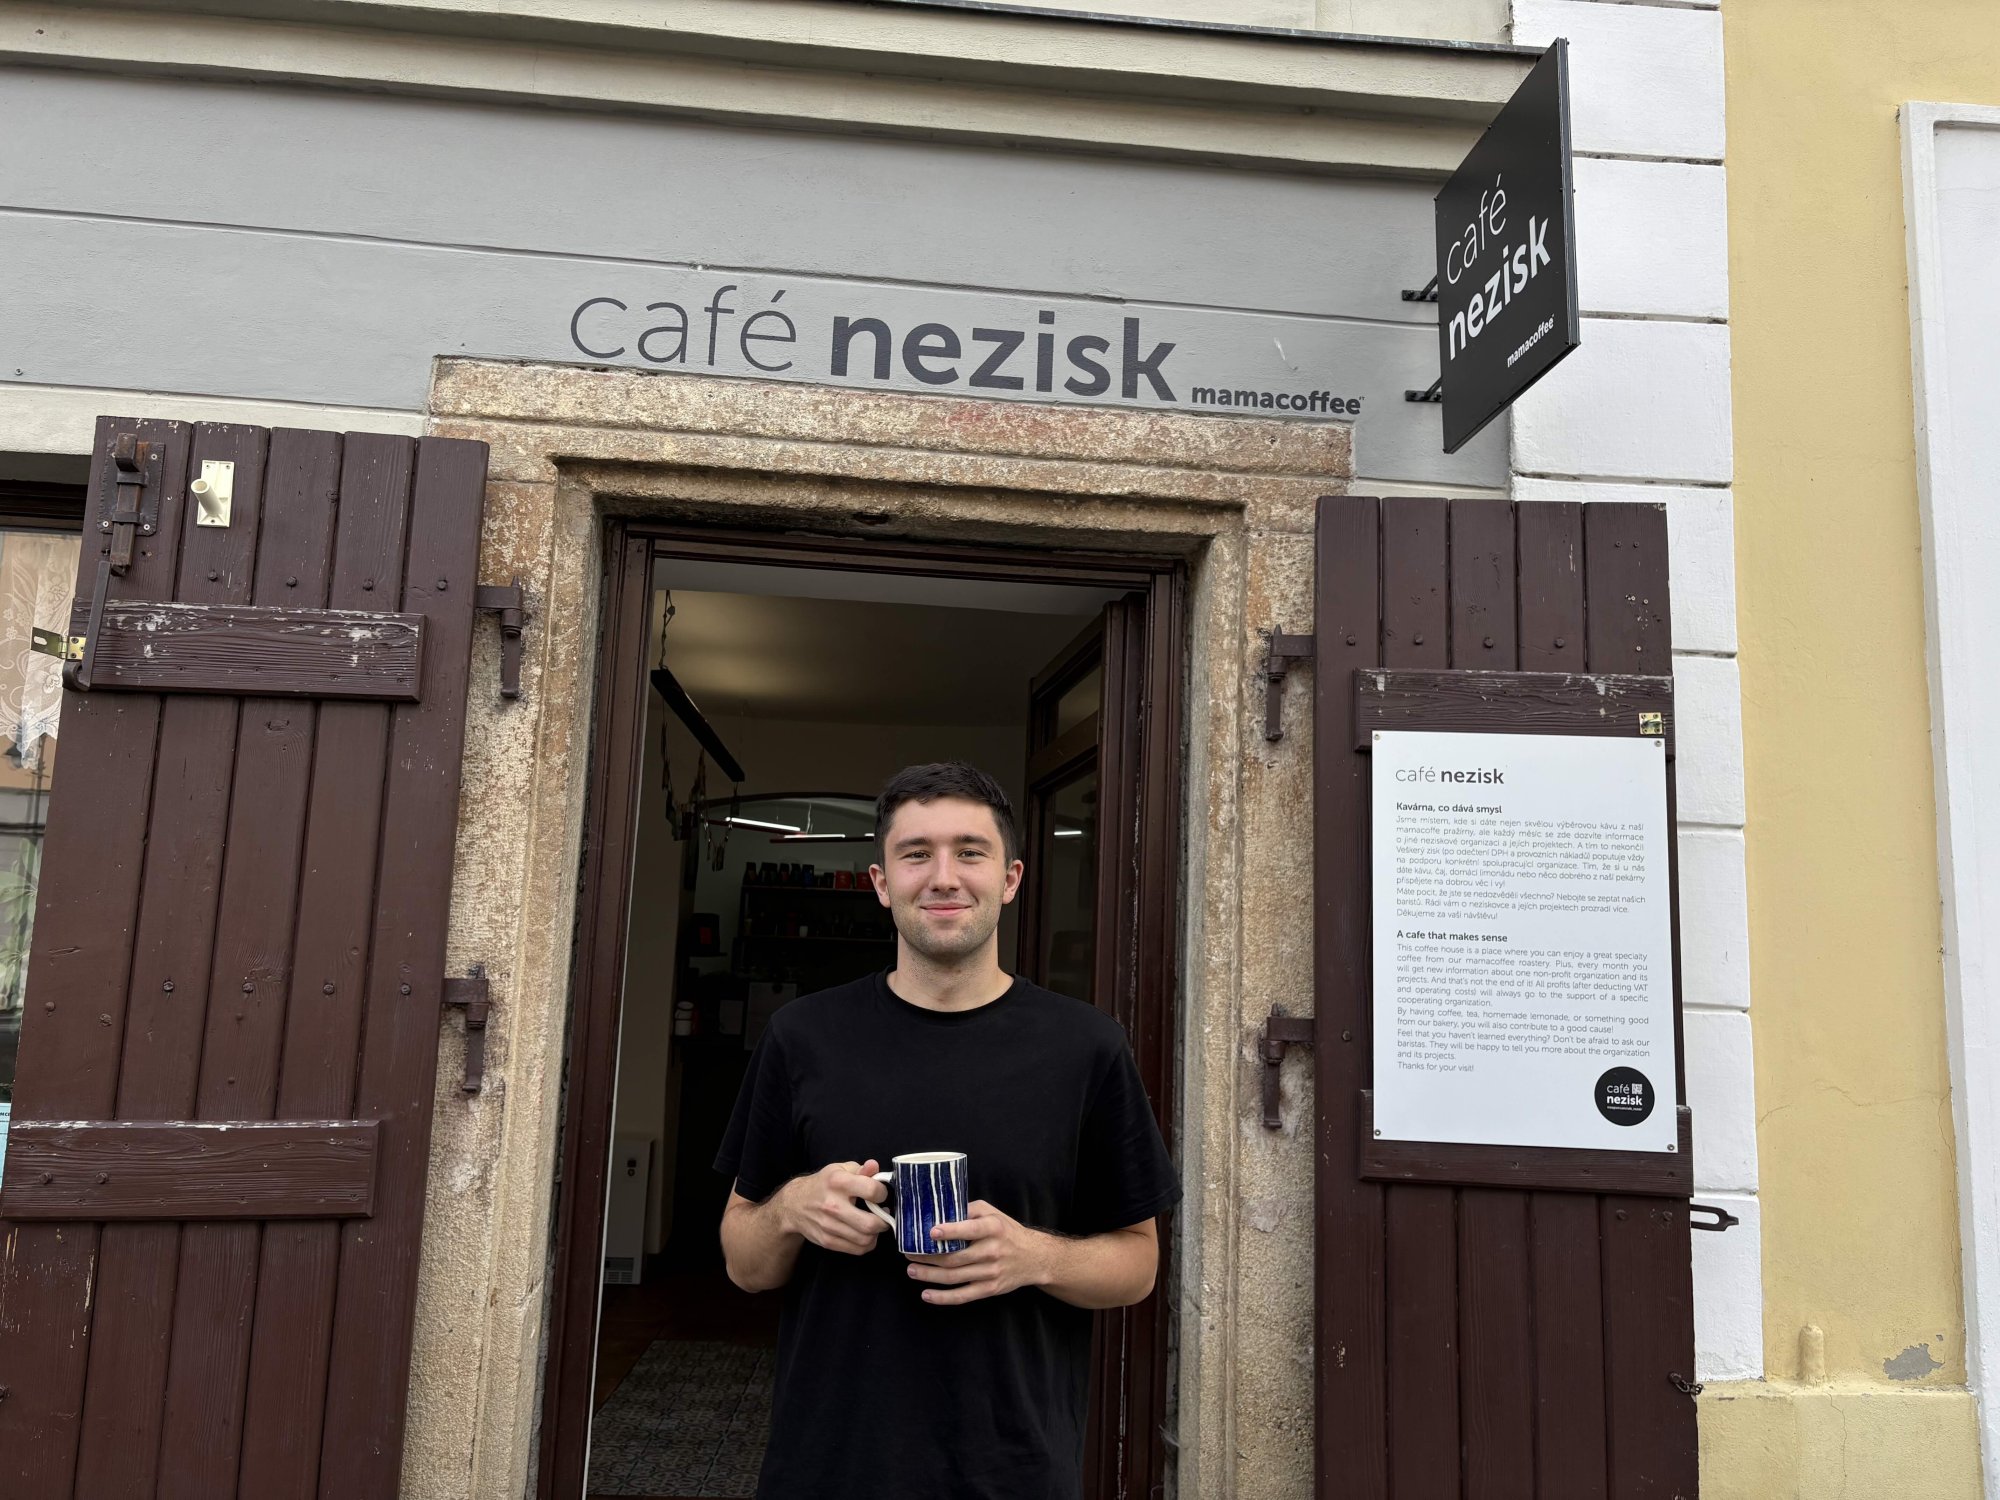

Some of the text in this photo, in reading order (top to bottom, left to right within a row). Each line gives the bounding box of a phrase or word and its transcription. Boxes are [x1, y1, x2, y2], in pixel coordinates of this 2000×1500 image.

[1447, 173, 1506, 284] café
[1449, 215, 1551, 360] nezisk
[1507, 316, 1554, 368] mamacoffee
[571, 285, 1361, 415] café nezisk mamacoffee
[1395, 766, 1504, 784] café nezisk
[1397, 802, 1436, 813] Kavárna,
[1452, 803, 1474, 812] dává
[1476, 804, 1502, 815] smysl
[1397, 815, 1521, 829] Jsme kde nejen
[1557, 830, 1571, 838] zde
[1409, 856, 1442, 867] podporu
[1491, 848, 1626, 862] DPH poputuje
[1517, 869, 1537, 878] nebo
[1445, 877, 1473, 886] dobrou
[1556, 891, 1586, 903] Nebojte
[1597, 893, 1620, 904] zeptat
[1405, 930, 1426, 939] cafe
[1428, 931, 1447, 939] that
[1449, 931, 1479, 940] makes
[1397, 943, 1413, 951] This
[1414, 943, 1439, 952] coffee
[1441, 944, 1464, 953] house
[1481, 946, 1502, 957] place
[1504, 947, 1528, 956] where
[1530, 950, 1545, 958] you
[1563, 951, 1584, 960] enjoy
[1593, 950, 1613, 961] great
[1615, 951, 1648, 962] specialty
[1397, 953, 1421, 962] coffee
[1426, 954, 1444, 963] from
[1466, 956, 1515, 966] mamacoffee
[1578, 962, 1599, 971] every
[1602, 961, 1629, 970] month
[1632, 964, 1648, 972] you
[1397, 964, 1409, 972] will
[1412, 964, 1424, 975] get
[1446, 965, 1489, 975] information
[1491, 967, 1513, 976] about
[1533, 969, 1571, 980] non-profit
[1573, 970, 1620, 982] organization
[1622, 972, 1637, 980] and
[1640, 972, 1648, 981] its
[1431, 975, 1446, 984] And
[1449, 976, 1468, 985] that's
[1470, 976, 1483, 985] not
[1485, 977, 1498, 986] the
[1500, 978, 1515, 986] end
[1517, 978, 1525, 987] of
[1535, 979, 1545, 987] All
[1546, 979, 1571, 990] profits
[1593, 981, 1632, 993] deducting
[1633, 982, 1648, 991] VAT
[1397, 984, 1412, 993] and
[1415, 985, 1451, 996] operating
[1480, 987, 1492, 996] will
[1496, 988, 1521, 999] always
[1538, 989, 1547, 998] to
[1550, 990, 1563, 999] the
[1567, 990, 1596, 1002] support
[1599, 992, 1608, 1000] of
[1620, 992, 1648, 1004] specific
[1397, 995, 1443, 1007] cooperating
[1397, 1006, 1407, 1017] By
[1410, 1006, 1435, 1018] having
[1483, 1009, 1527, 1019] homemade
[1585, 1013, 1626, 1025] something
[1628, 1015, 1649, 1026] good
[1397, 1016, 1416, 1025] from
[1461, 1021, 1476, 1030] you
[1478, 1019, 1490, 1028] will
[1492, 1020, 1508, 1029] also
[1510, 1021, 1548, 1031] contribute
[1550, 1022, 1558, 1031] to
[1566, 1023, 1588, 1034] good
[1589, 1024, 1614, 1033] cause!
[1398, 1028, 1412, 1037] Feel
[1415, 1028, 1429, 1037] that
[1432, 1032, 1446, 1040] you
[1448, 1030, 1475, 1039] haven't
[1478, 1031, 1506, 1040] learned
[1508, 1032, 1551, 1044] everything?
[1553, 1034, 1574, 1043] Don't
[1576, 1035, 1586, 1043] be
[1588, 1035, 1609, 1044] afraid
[1611, 1036, 1620, 1045] to
[1621, 1036, 1634, 1045] ask
[1397, 1049, 1412, 1058] and
[1414, 1050, 1423, 1058] its
[1430, 1040, 1448, 1051] They
[1450, 1040, 1462, 1049] will
[1465, 1041, 1475, 1050] be
[1477, 1042, 1500, 1053] happy
[1502, 1042, 1510, 1051] to
[1512, 1043, 1523, 1052] tell
[1525, 1046, 1539, 1054] you
[1564, 1045, 1586, 1054] about
[1588, 1046, 1601, 1055] the
[1603, 1046, 1650, 1059] organization
[1397, 1060, 1474, 1073] Thanks for your visit!
[1607, 1084, 1630, 1094] café
[1607, 1095, 1643, 1106] nezisk
